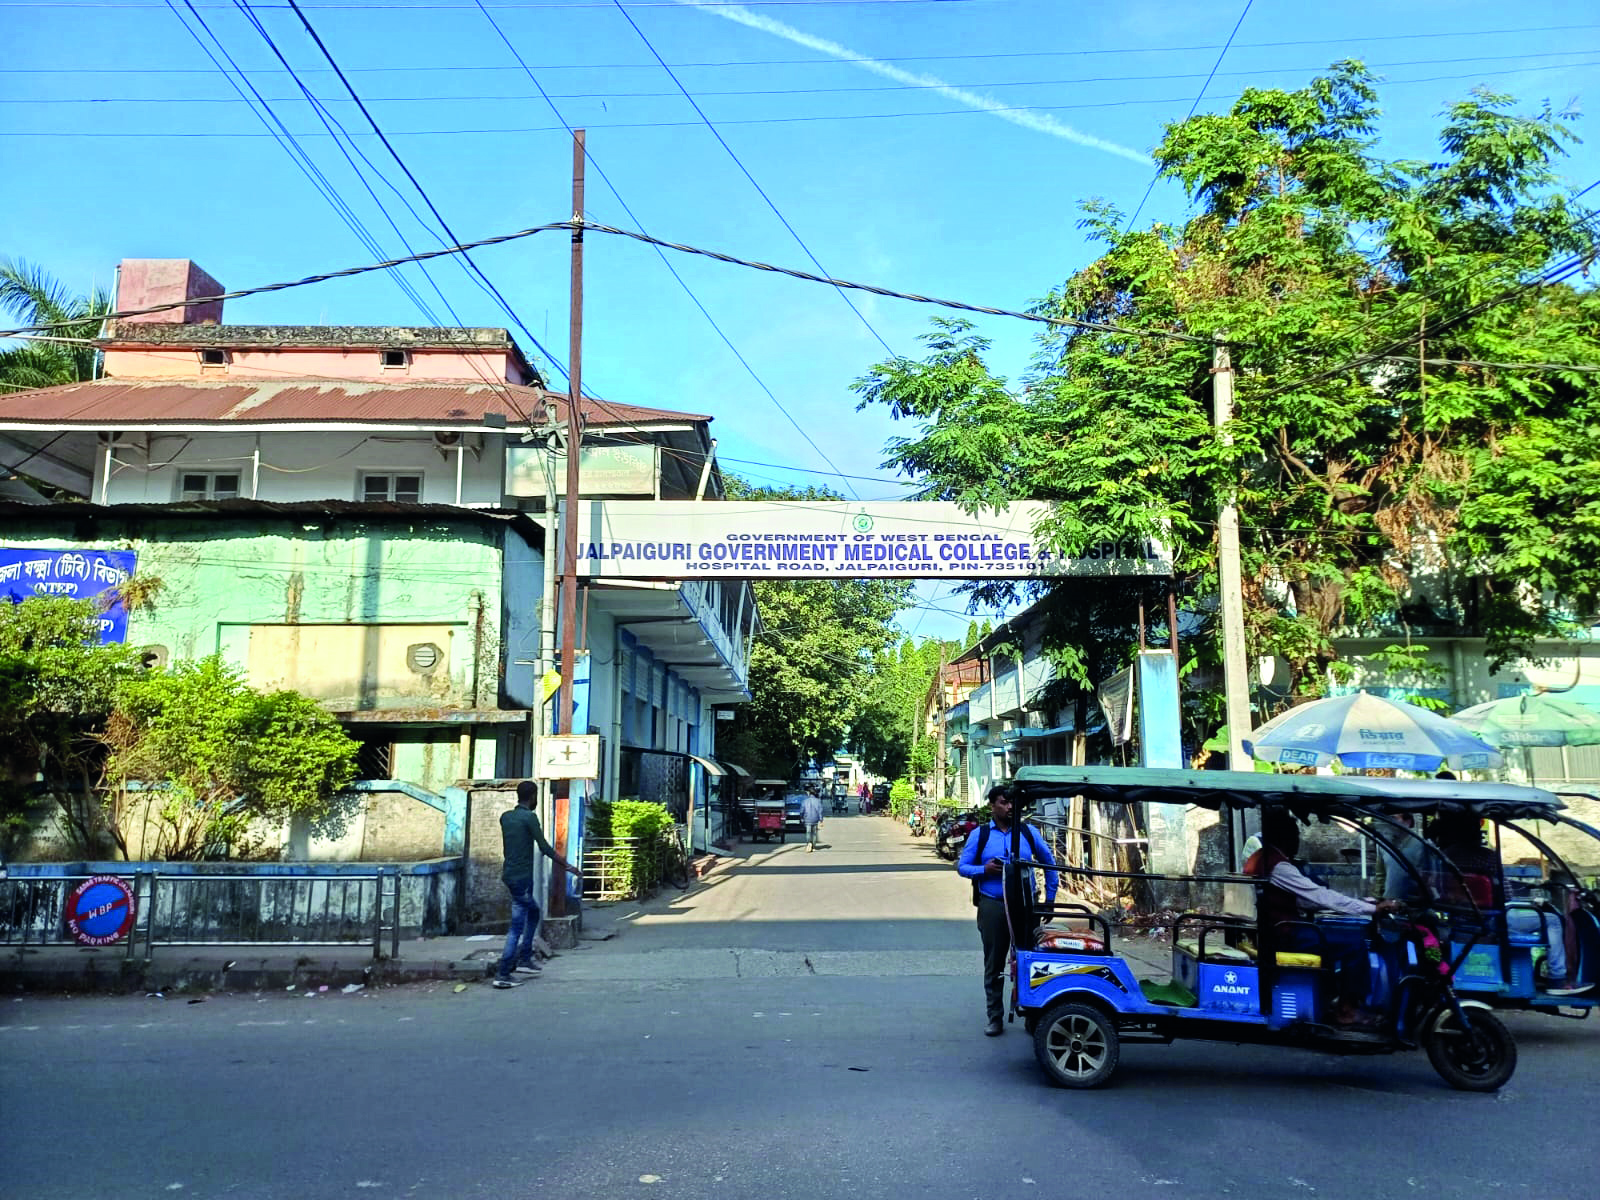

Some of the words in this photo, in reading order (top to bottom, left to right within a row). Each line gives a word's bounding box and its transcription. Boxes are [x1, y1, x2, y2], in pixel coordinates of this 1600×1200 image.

[726, 533, 847, 542] GOVERNMENT
[853, 533, 875, 542] OF
[880, 533, 928, 542] WEST
[934, 533, 1003, 542] BENGAL
[576, 542, 691, 560] JALPAIGURI
[698, 543, 838, 561] GOVERNMENT
[844, 543, 932, 561] MEDICAL
[939, 542, 1031, 561] COLLEGE
[686, 562, 771, 571] HOSPITAL
[777, 562, 829, 572] ROAD,
[835, 562, 943, 572] JALPAIGURI,
[1282, 750, 1314, 762] DEAR
[68, 919, 79, 934] NO
[79, 932, 120, 946] PARKING
[1213, 984, 1251, 995] ANANT
